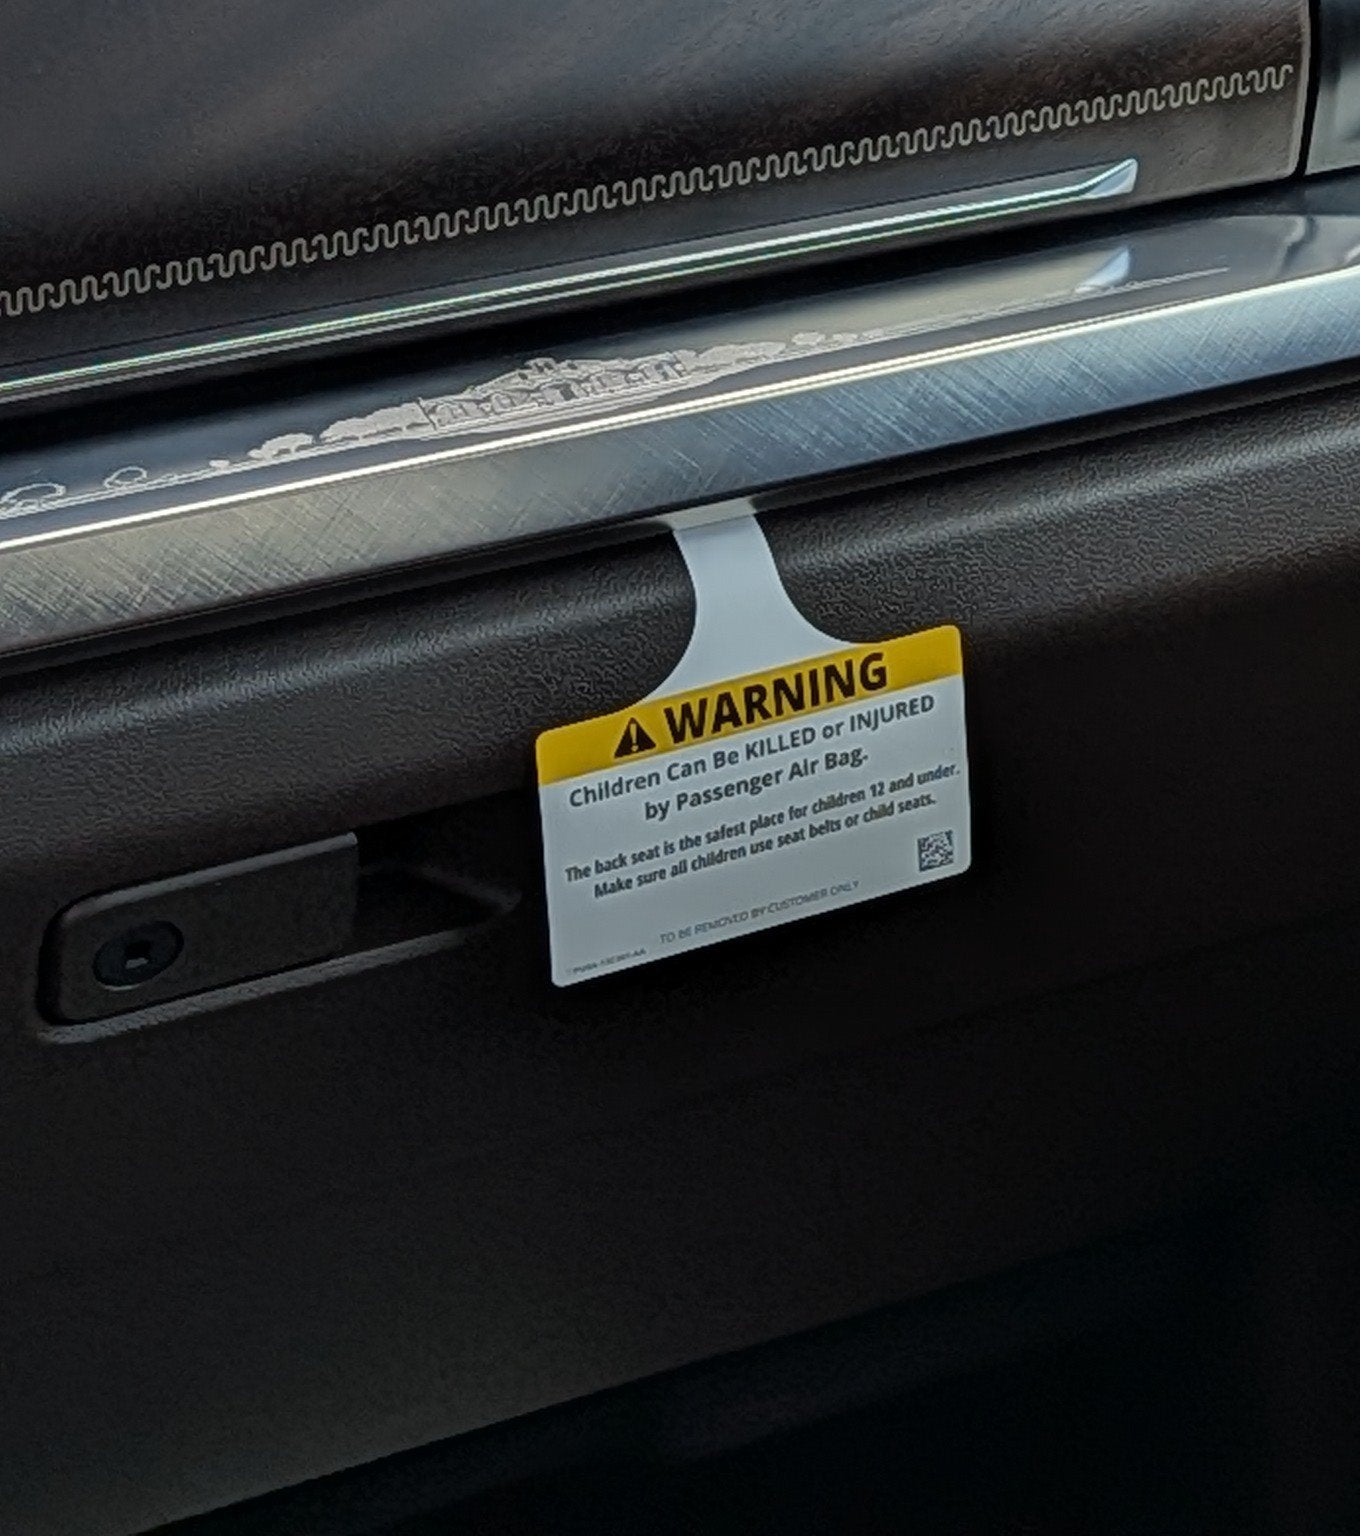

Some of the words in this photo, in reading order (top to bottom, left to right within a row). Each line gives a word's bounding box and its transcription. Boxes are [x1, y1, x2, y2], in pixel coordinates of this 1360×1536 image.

[663, 652, 888, 744] WARNING
[569, 772, 661, 808] Children
[667, 758, 707, 781] Can
[713, 750, 739, 769] Be
[746, 727, 817, 760] KILLED
[822, 721, 845, 739] or
[850, 694, 935, 732] INJURED
[645, 800, 670, 821] by
[676, 768, 783, 811] Passenger
[788, 758, 819, 781] Air
[825, 747, 869, 770] Bag.
[565, 865, 592, 882] The
[595, 853, 629, 875] back
[631, 845, 660, 865] seat
[664, 840, 676, 856] is
[679, 834, 702, 852] the
[706, 821, 746, 844] safest
[750, 810, 785, 836] place
[788, 803, 808, 821] for
[812, 788, 866, 815] children
[870, 781, 885, 798] 12
[889, 772, 914, 794] and
[917, 763, 962, 786] under.
[594, 877, 634, 898] Make
[636, 867, 667, 888] sure
[671, 859, 688, 878] all
[691, 845, 747, 872] children
[750, 839, 773, 854] use
[777, 827, 806, 848] seat
[809, 817, 842, 839] belts
[844, 813, 860, 829] or
[863, 800, 895, 823] child
[898, 792, 937, 814] seats.
[660, 932, 676, 945] TO
[679, 926, 693, 939] BE
[694, 910, 749, 935] REMOVED
[767, 888, 828, 914] CUSTOMER
